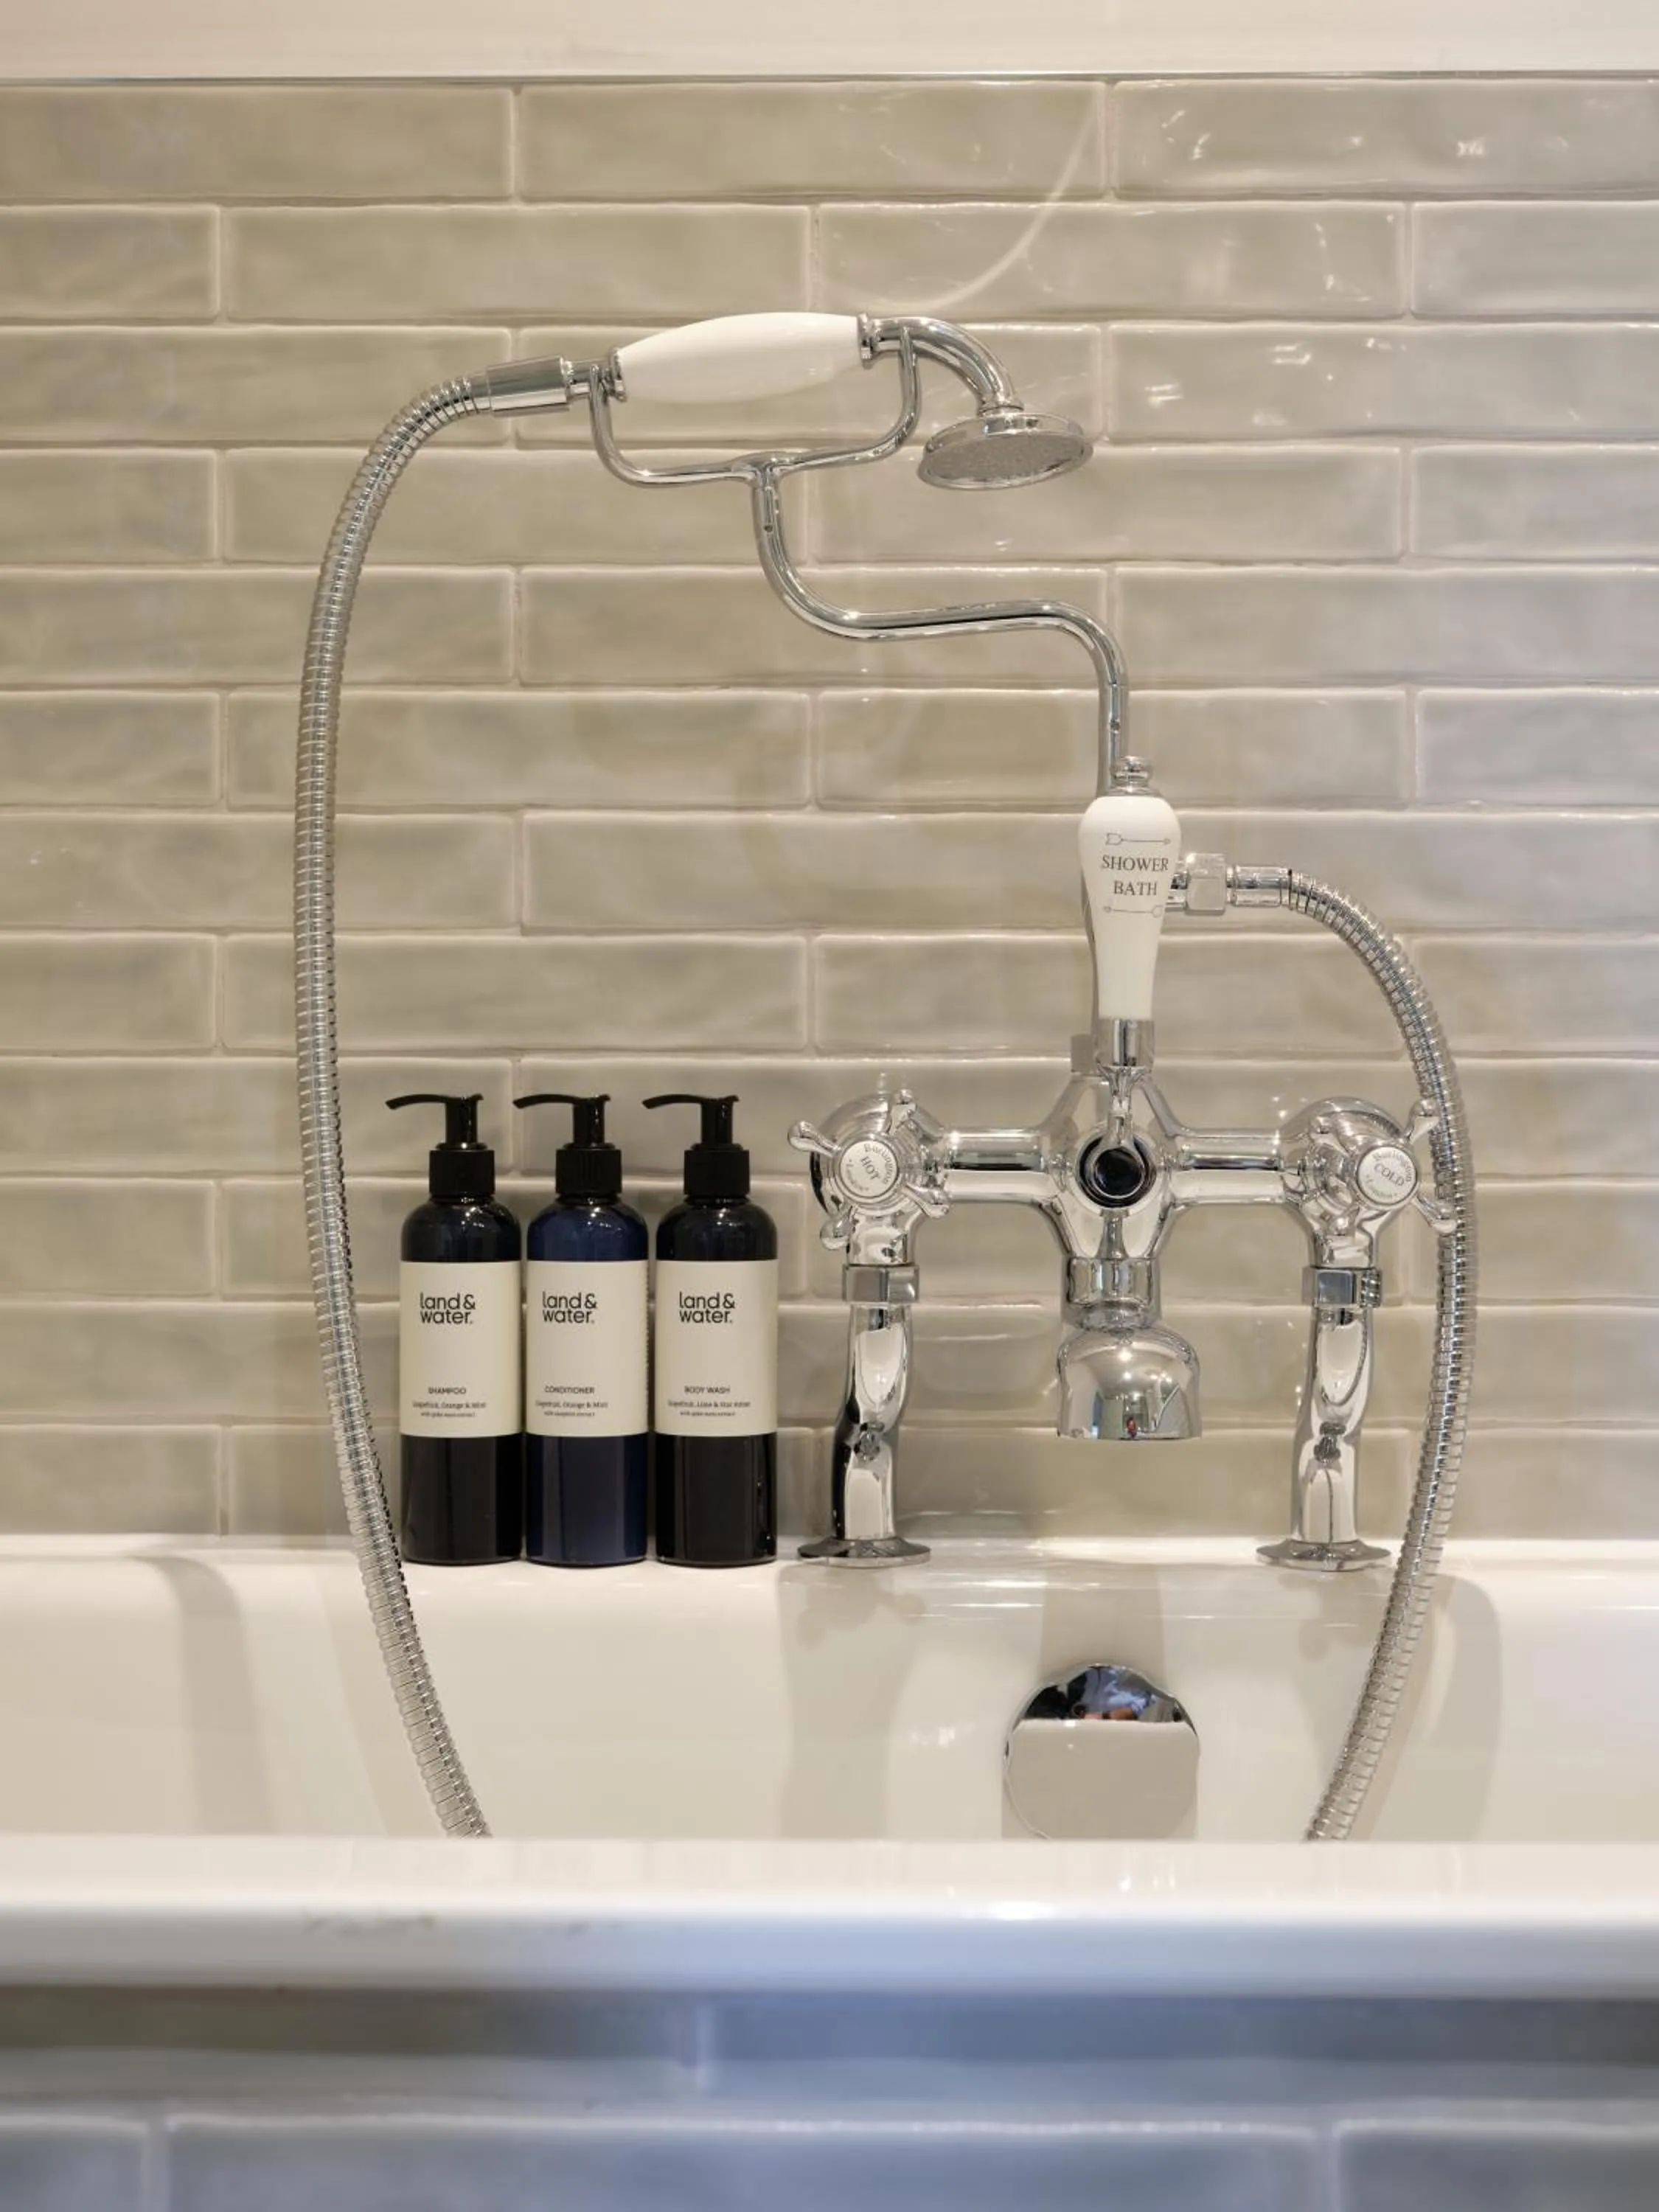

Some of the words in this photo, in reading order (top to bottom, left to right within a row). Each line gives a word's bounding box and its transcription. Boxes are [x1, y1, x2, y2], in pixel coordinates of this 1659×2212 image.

[1101, 855, 1169, 872] SHOWER
[1113, 880, 1158, 897] BATH
[860, 1155, 881, 1180] HOT
[1374, 1163, 1405, 1186] COLD
[428, 1386, 467, 1394] SHAMPOO
[544, 1385, 595, 1394] CONDITIONER
[684, 1385, 705, 1394] BODY
[706, 1386, 731, 1394] WASH
